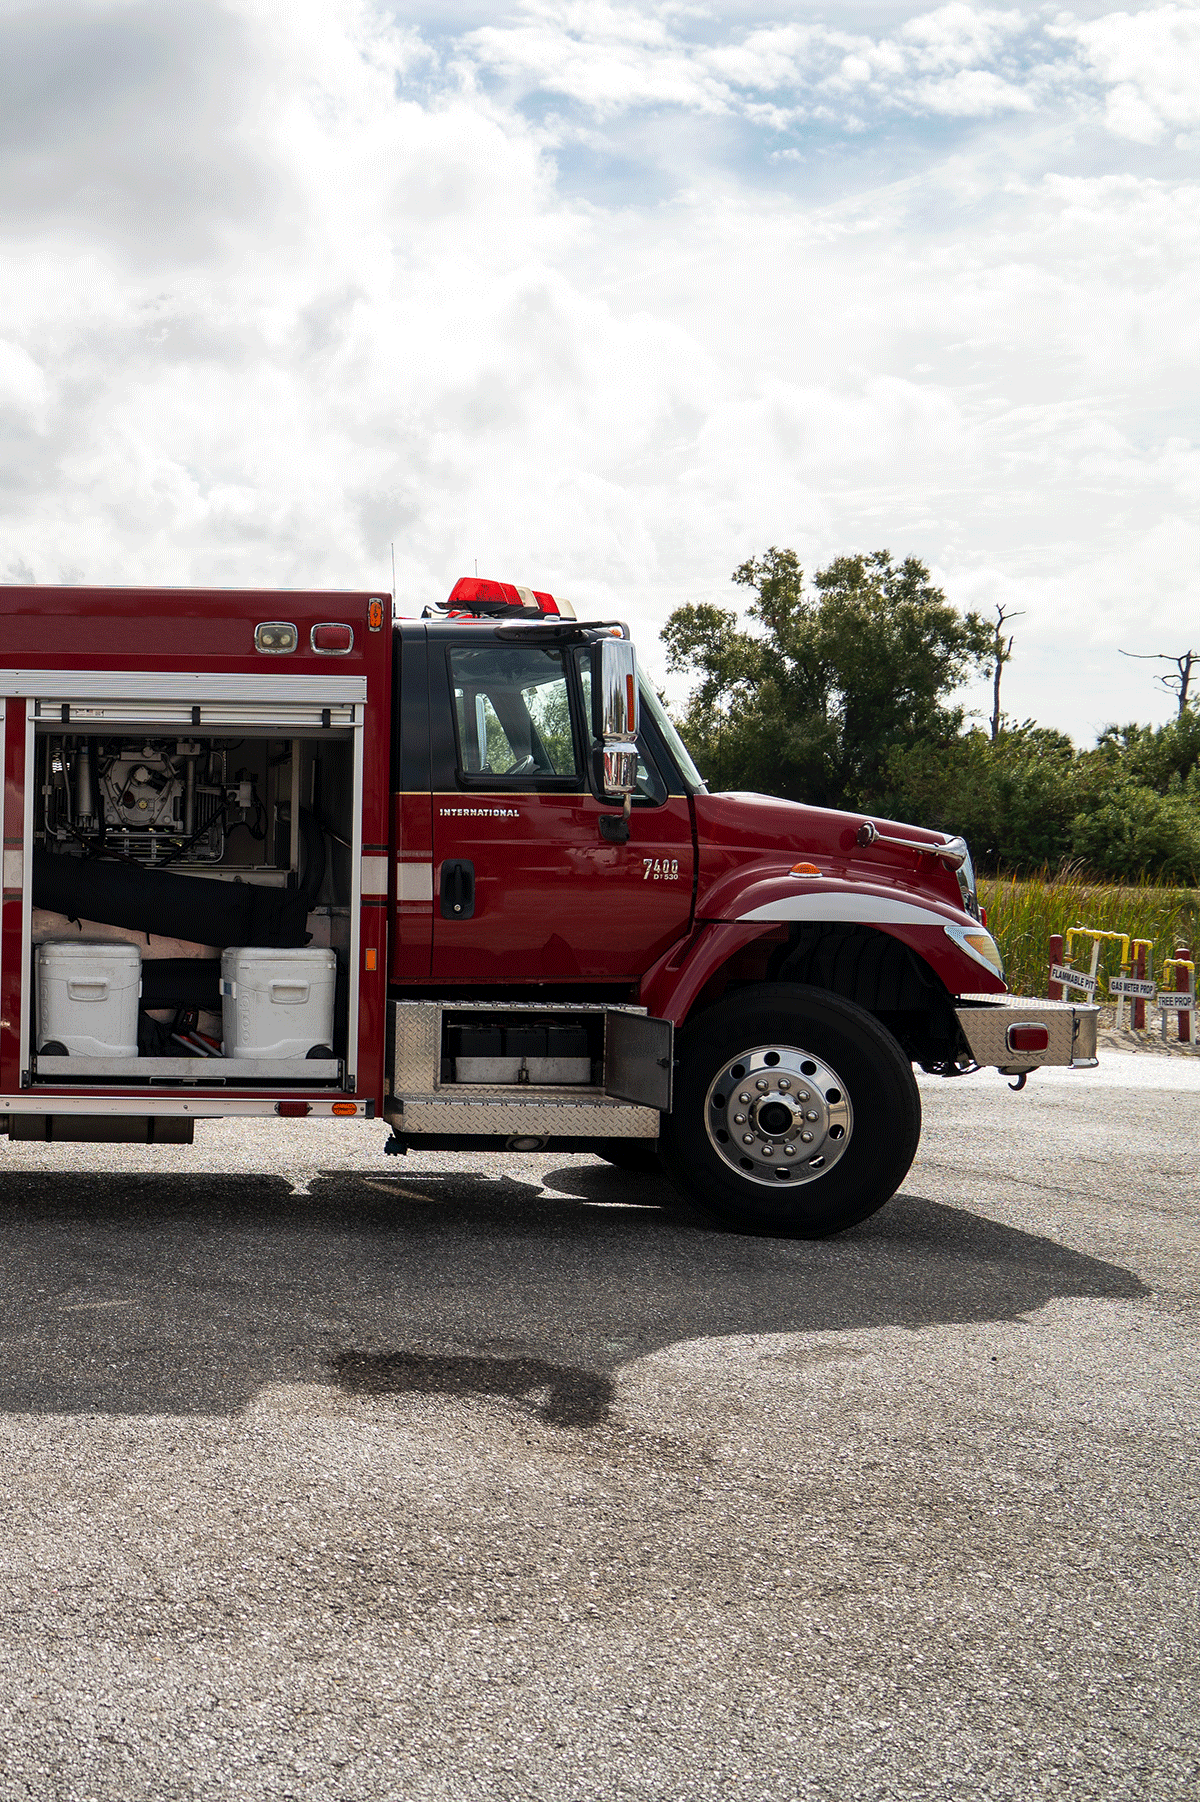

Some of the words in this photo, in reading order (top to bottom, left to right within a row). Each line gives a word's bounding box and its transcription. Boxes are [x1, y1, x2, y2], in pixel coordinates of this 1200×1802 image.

[439, 808, 520, 817] INTERNATIONAL
[643, 858, 679, 880] 7400
[1051, 968, 1084, 987] FLAMMABLE
[1084, 979, 1094, 990] PIT
[1111, 981, 1123, 991] GAS
[1140, 984, 1153, 994] PROP
[1158, 996, 1174, 1006] TREE
[1174, 996, 1192, 1006] PROP
